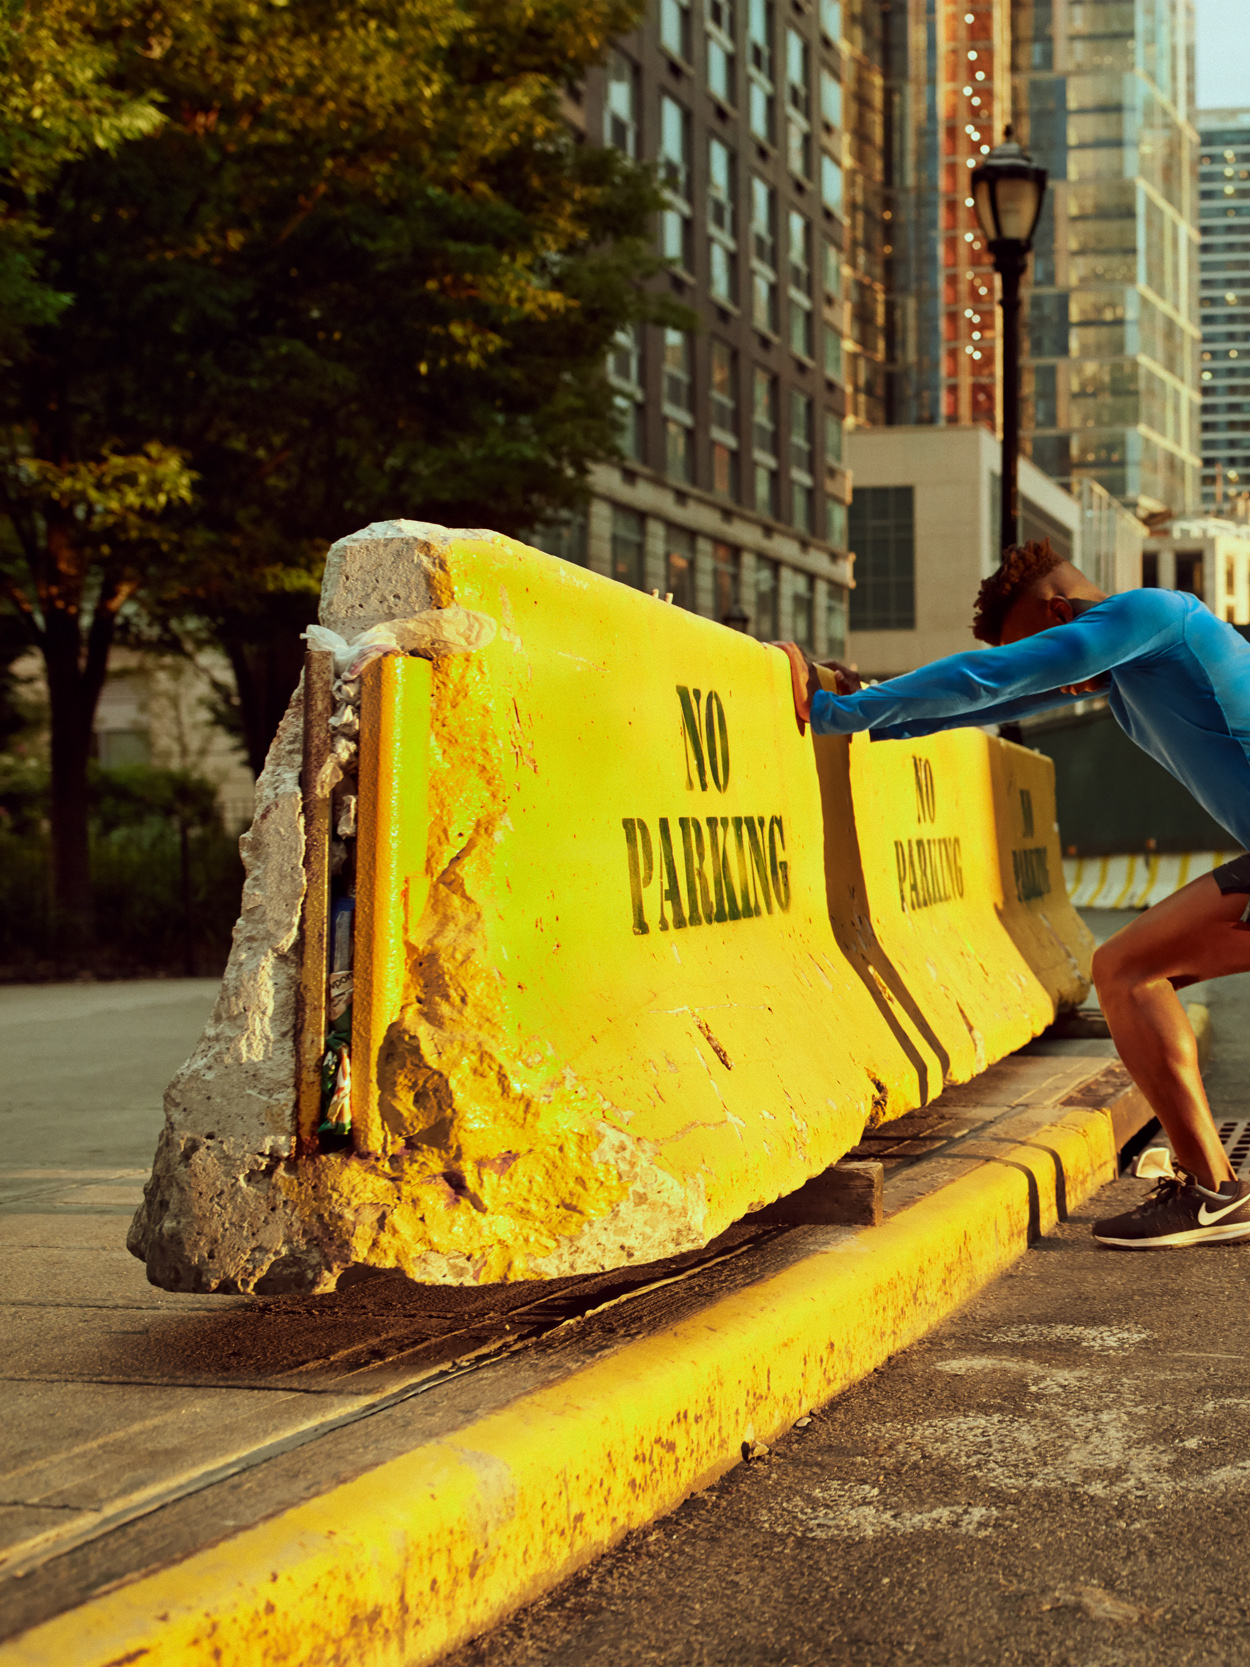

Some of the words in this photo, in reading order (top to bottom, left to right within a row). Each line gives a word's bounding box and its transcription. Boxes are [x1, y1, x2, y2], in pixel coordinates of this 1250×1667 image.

[676, 685, 729, 794] NO
[912, 755, 935, 824] NO
[622, 815, 791, 935] PARKING
[894, 837, 964, 912] PARKING
